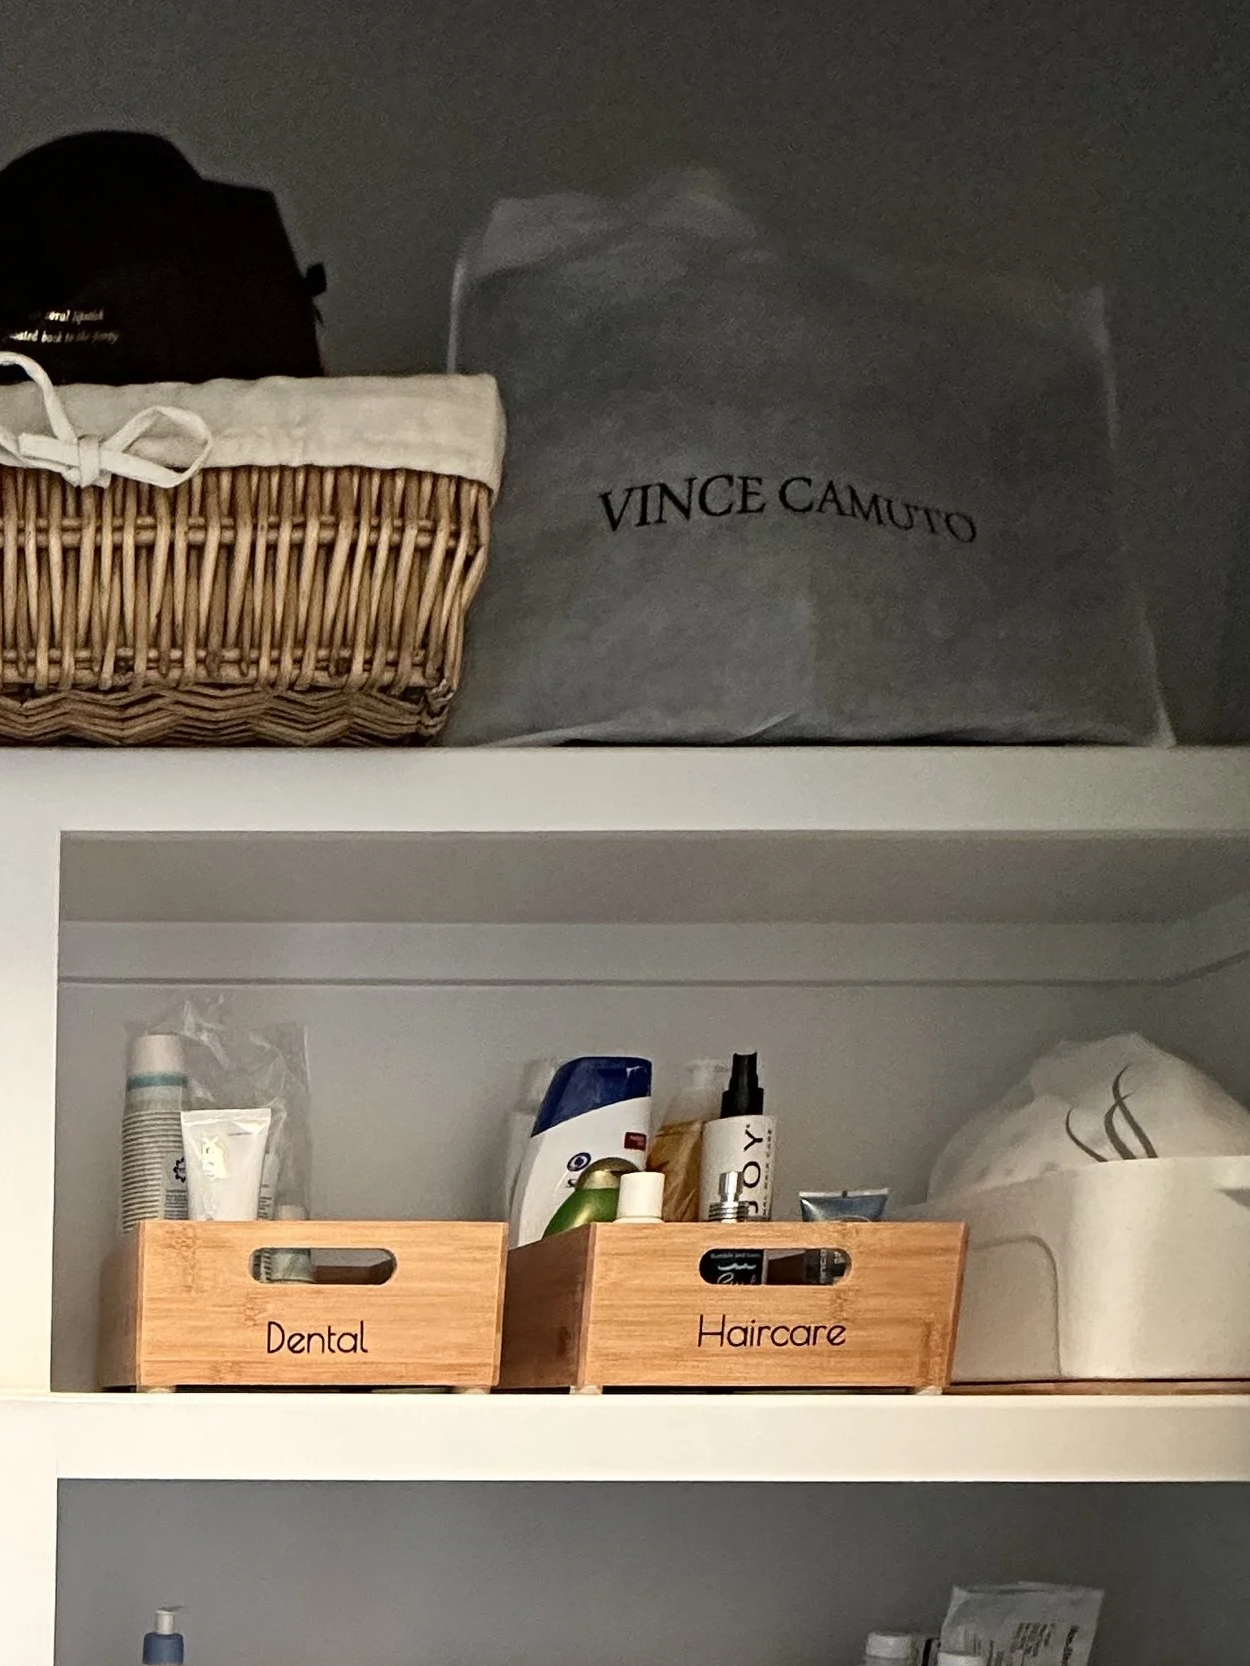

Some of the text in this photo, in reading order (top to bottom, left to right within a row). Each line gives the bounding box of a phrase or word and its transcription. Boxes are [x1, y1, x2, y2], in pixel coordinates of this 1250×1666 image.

[598, 473, 977, 543] VINCE CAMUTO
[266, 1320, 368, 1354] Dental
[698, 1314, 847, 1348] Haircare
